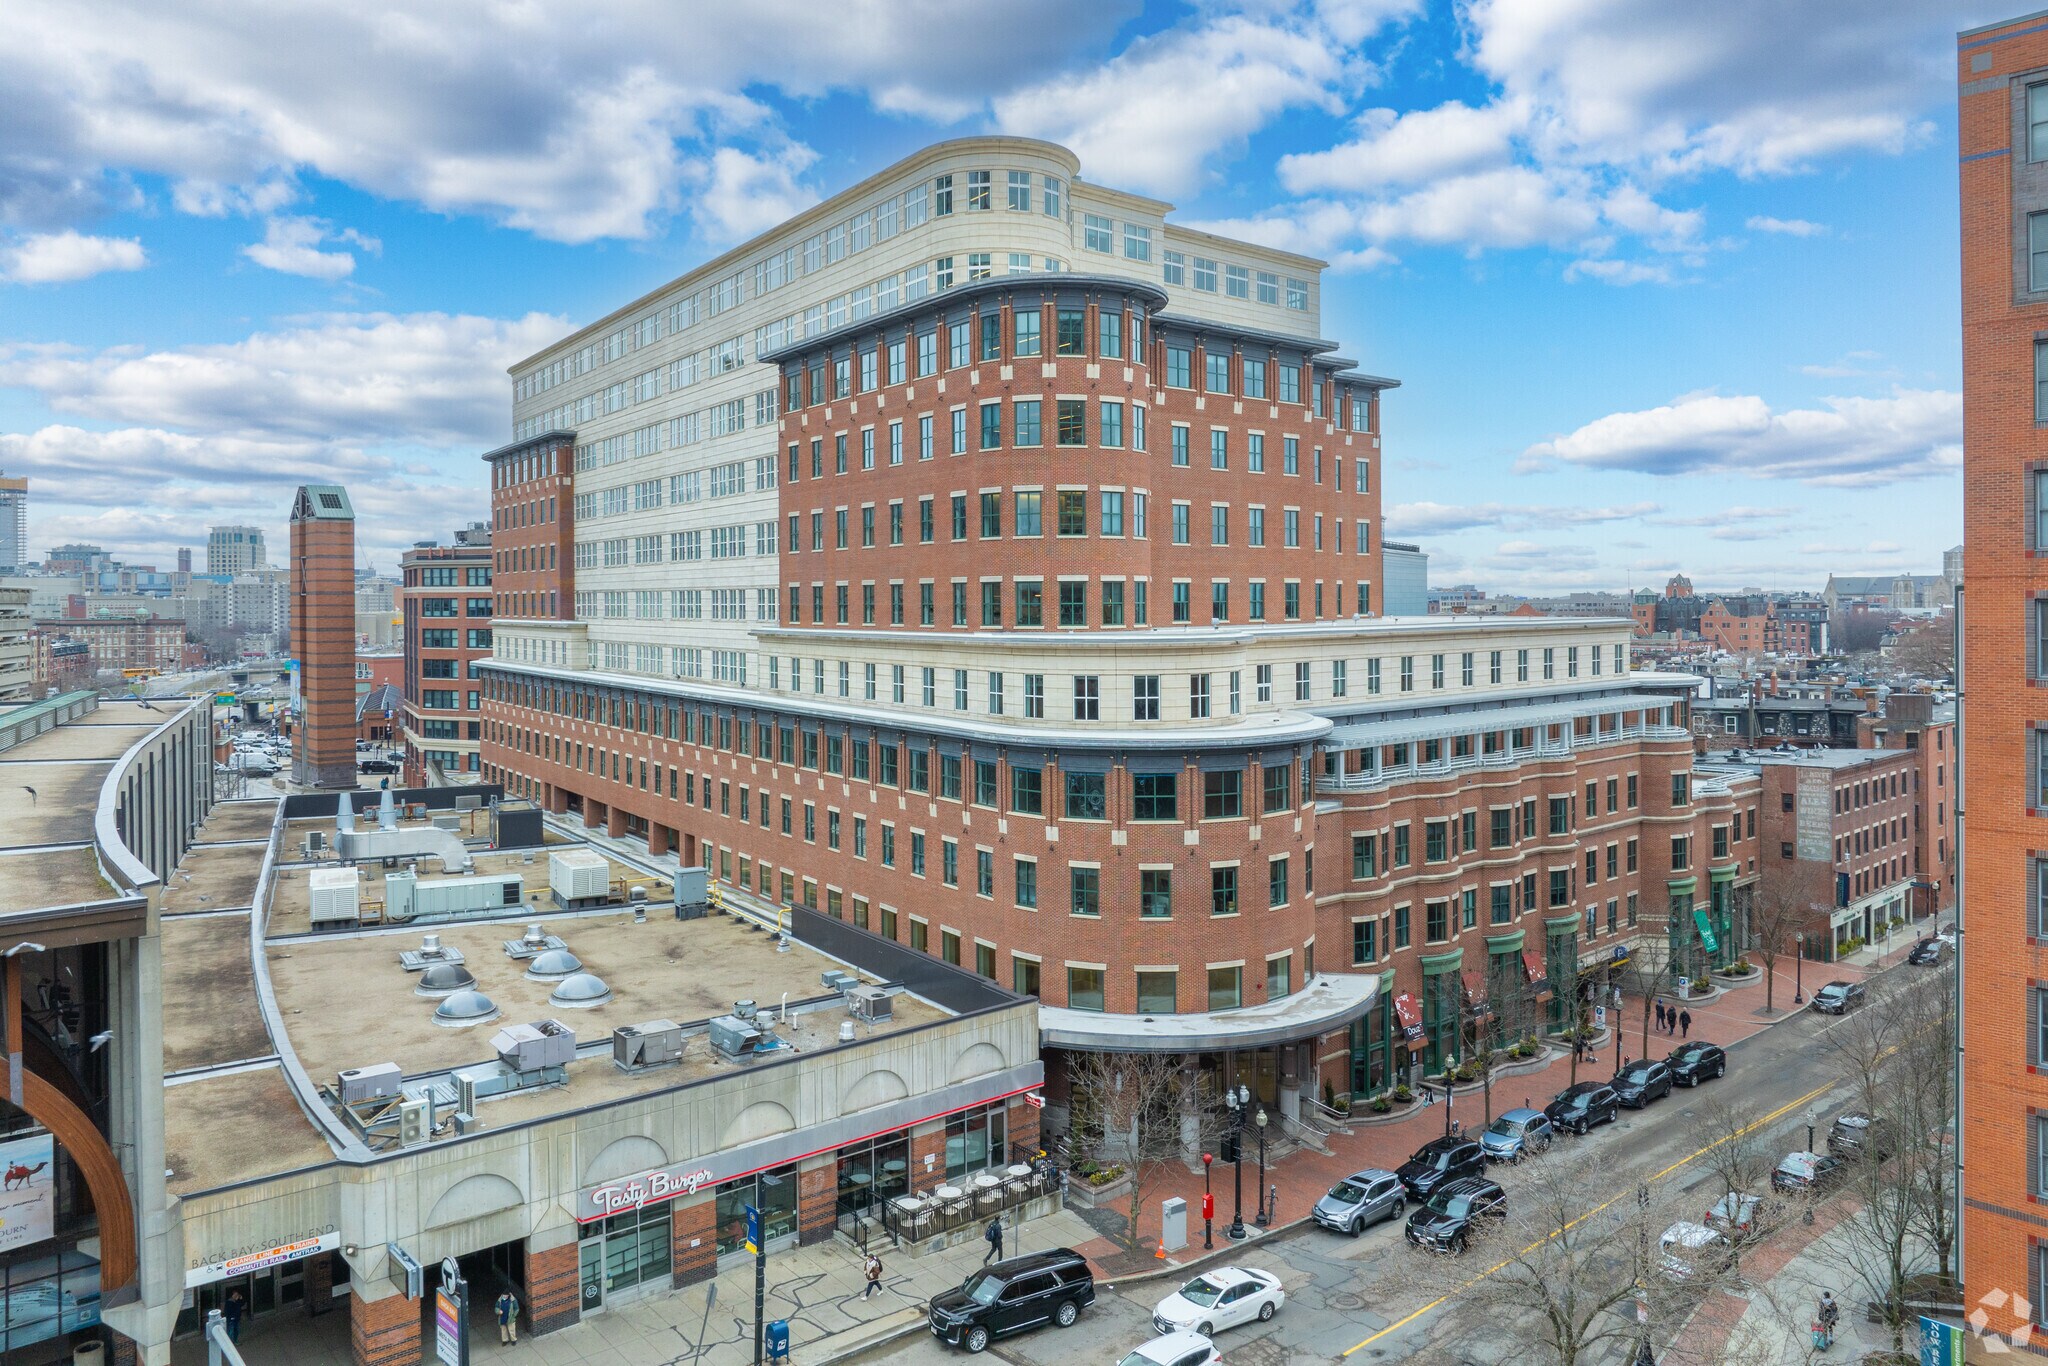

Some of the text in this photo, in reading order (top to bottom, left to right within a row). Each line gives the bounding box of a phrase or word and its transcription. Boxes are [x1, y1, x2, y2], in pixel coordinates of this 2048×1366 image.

[592, 1169, 713, 1215] Tasty Burger
[191, 1251, 227, 1269] BACK
[308, 1224, 335, 1239] END
[229, 1254, 257, 1267] ORANGE
[258, 1250, 273, 1261] LINE
[280, 1246, 292, 1255] ALL
[293, 1239, 317, 1250] TRAINS
[291, 1246, 319, 1258] AMTRAK
[229, 1255, 286, 1275] COMMUTER RAIL
[443, 1268, 453, 1291] T
